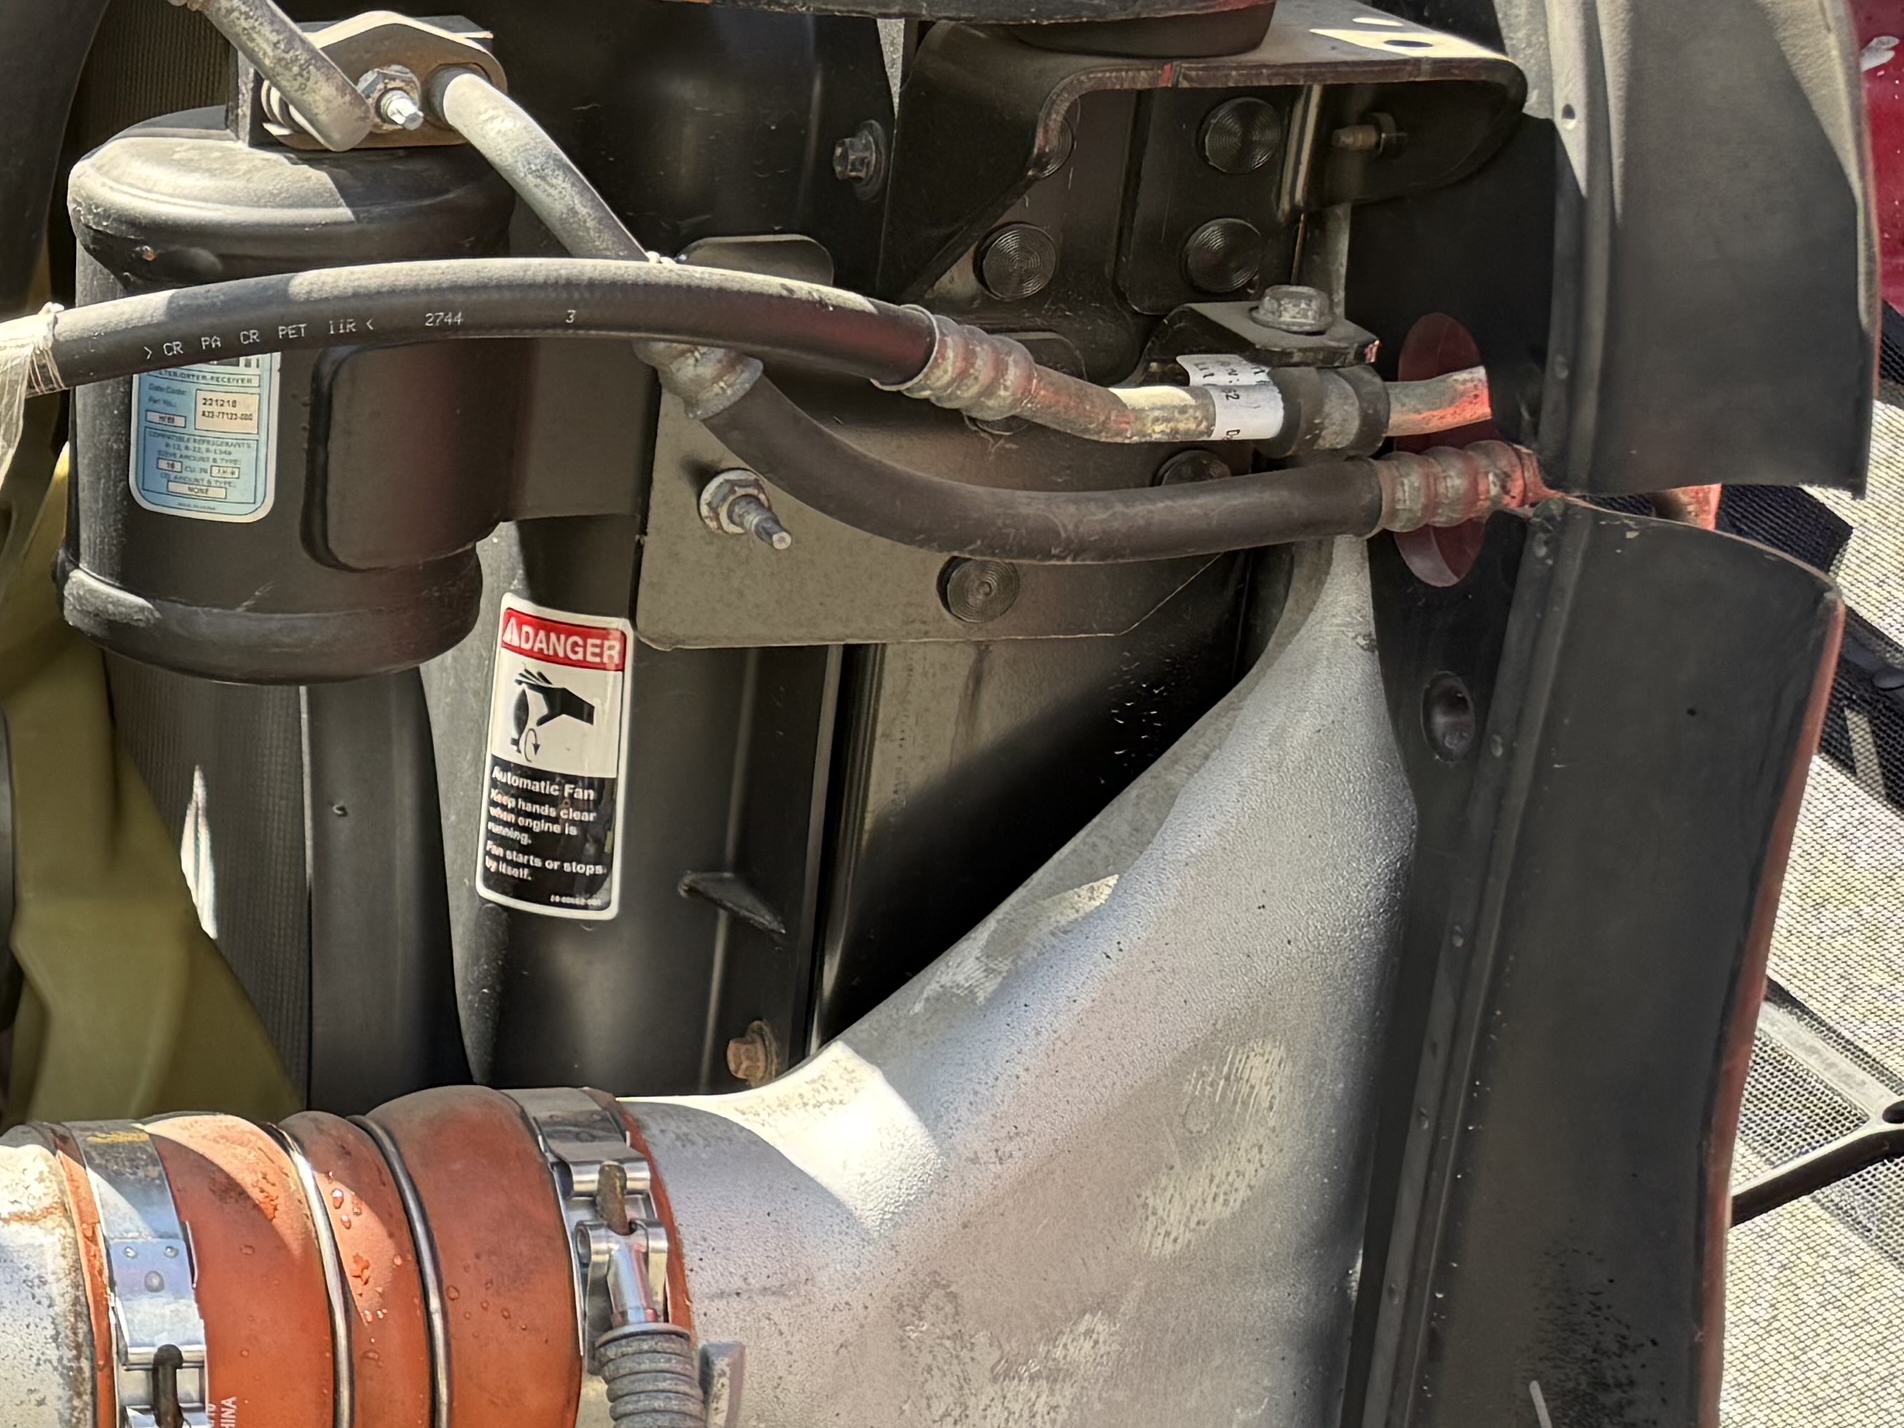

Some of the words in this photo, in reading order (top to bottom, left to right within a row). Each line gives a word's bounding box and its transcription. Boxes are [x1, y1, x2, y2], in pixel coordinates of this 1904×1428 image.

[163, 341, 184, 357] CR
[201, 336, 222, 351] PA
[240, 329, 261, 345] CR
[278, 324, 308, 340] PET
[425, 311, 464, 327] 2744
[565, 309, 577, 324] 3
[520, 626, 621, 665] DANGER
[492, 765, 559, 796] Automatic
[564, 783, 595, 801] Fan
[490, 788, 516, 809] Keep
[518, 798, 557, 818] hands
[560, 807, 597, 821] clear
[488, 821, 532, 846] running.
[489, 806, 516, 824] when
[518, 815, 562, 834] engine
[565, 822, 578, 836] is
[485, 855, 499, 872] by
[499, 860, 532, 881] itself.
[486, 840, 504, 857] Fan
[505, 850, 542, 868] starts
[545, 859, 561, 871] or
